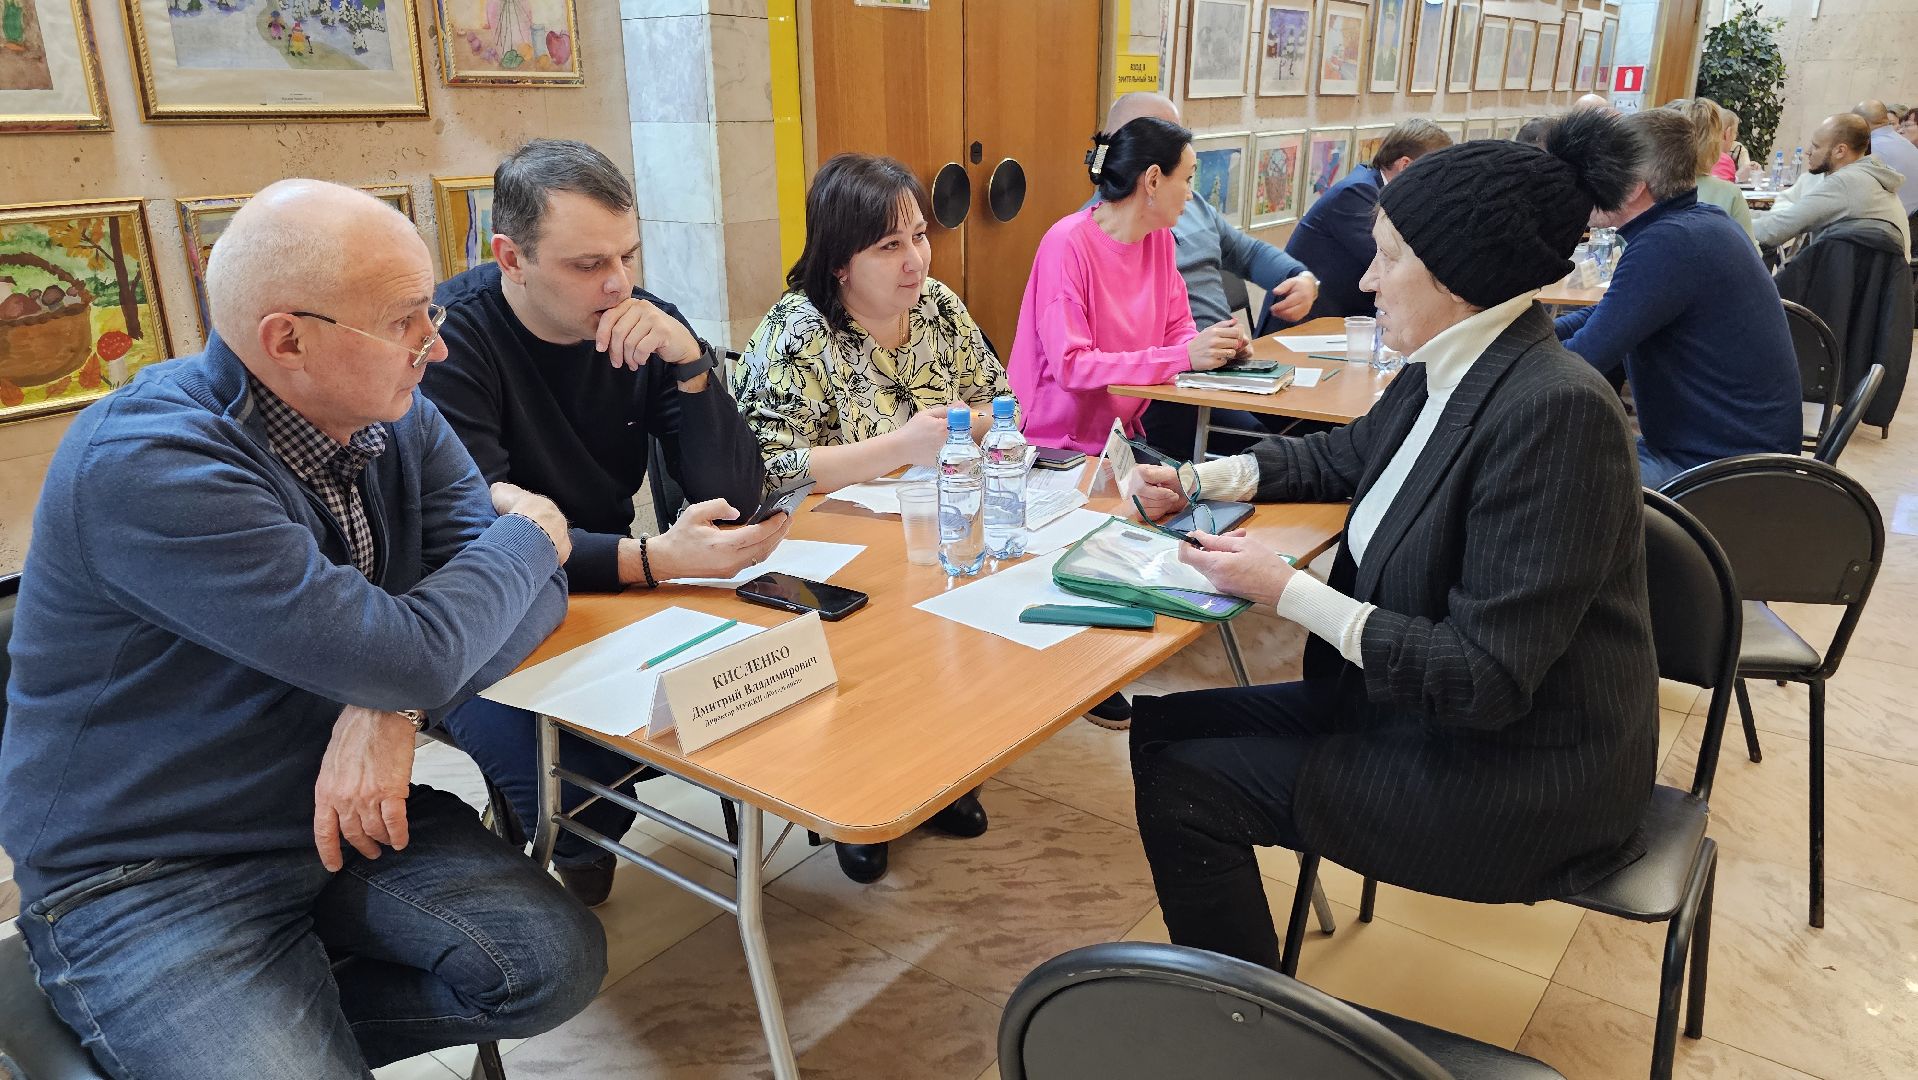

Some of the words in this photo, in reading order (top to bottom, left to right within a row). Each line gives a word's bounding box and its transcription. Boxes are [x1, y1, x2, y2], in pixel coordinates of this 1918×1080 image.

[692, 688, 743, 721] Дмитрий
[744, 656, 818, 695] Владимирович
[712, 645, 790, 689] КИСЛЕНКО
